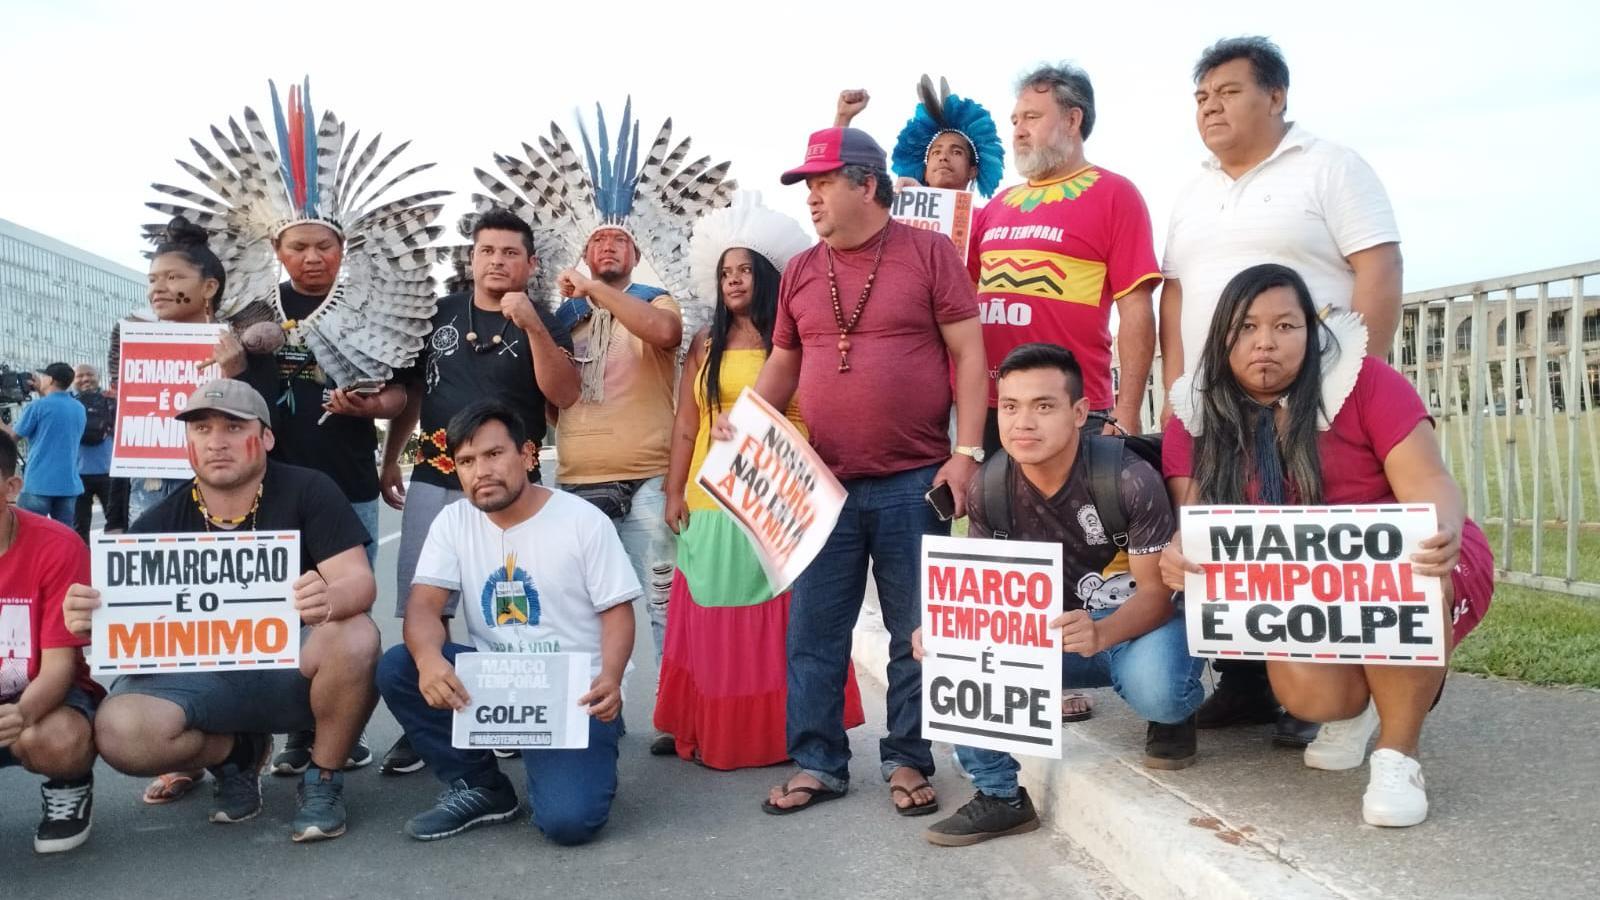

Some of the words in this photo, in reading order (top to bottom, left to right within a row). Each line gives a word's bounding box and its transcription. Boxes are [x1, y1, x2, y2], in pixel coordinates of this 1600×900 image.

[893, 191, 942, 218] PRE
[1009, 225, 1064, 243] TEMPORAL
[159, 388, 171, 411] É
[173, 392, 188, 411] O
[1209, 522, 1403, 562] MARCO
[107, 543, 288, 590] DEMARCAÇÃO
[1201, 562, 1426, 603] TEMPORAL
[176, 588, 193, 614] É
[198, 592, 220, 612] O
[928, 565, 1054, 610] MARCO
[107, 615, 289, 660] MÍNIMO
[927, 604, 1054, 648] TEMPORAL
[1201, 597, 1233, 641] É
[1245, 603, 1433, 645] GOLPE
[481, 659, 546, 674] MARCO
[981, 646, 996, 674] É
[476, 674, 551, 688] TEMPORAL
[476, 705, 548, 724] GOLPE
[929, 675, 1052, 730] GOLPE
